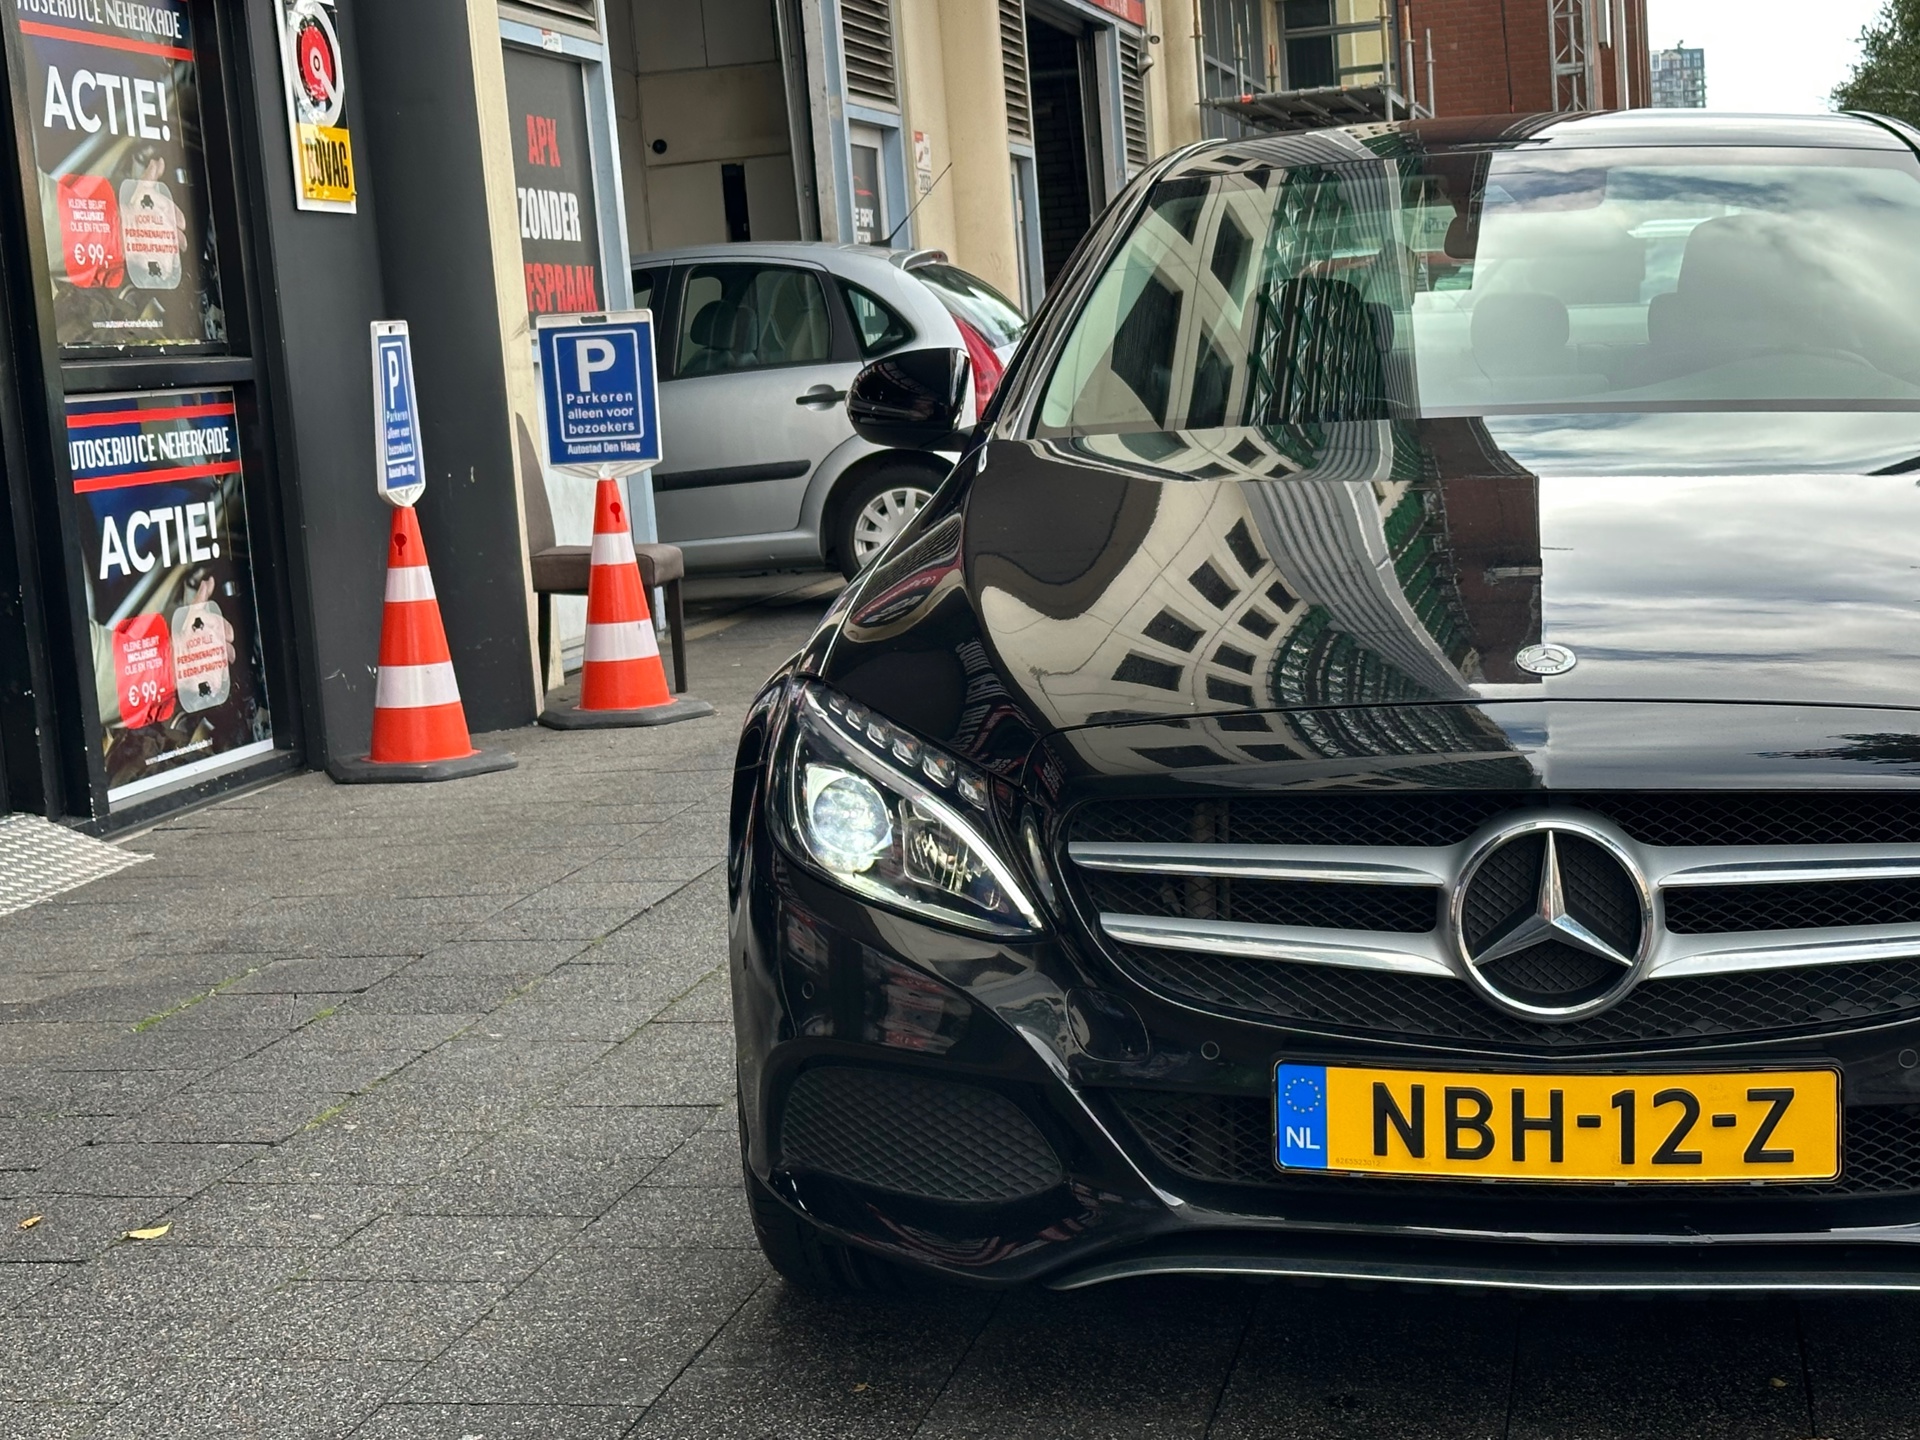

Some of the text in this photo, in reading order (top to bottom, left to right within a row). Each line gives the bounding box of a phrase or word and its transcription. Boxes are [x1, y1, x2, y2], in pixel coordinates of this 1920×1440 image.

[105, 0, 182, 39] NEHERKADE
[44, 65, 171, 142] ACTIE!
[305, 138, 349, 189] BOVAG
[526, 114, 561, 167] APK
[518, 187, 581, 242] ZONDER
[74, 243, 113, 269] € 99,-
[525, 263, 598, 312] FSPRAAK
[387, 350, 399, 409] P
[575, 339, 616, 392] P
[566, 392, 633, 405] Parkeren
[568, 407, 634, 420] alleen voor
[69, 426, 231, 471] UTOSERVICE NEHERKADE
[568, 441, 641, 455] Autostad Den Haag
[569, 421, 635, 435] bezoekers
[99, 501, 220, 580] ACTIE!
[128, 680, 165, 707] € 99,-
[1286, 1126, 1320, 1149] NL
[1373, 1082, 1795, 1164] NBH-12-Z
